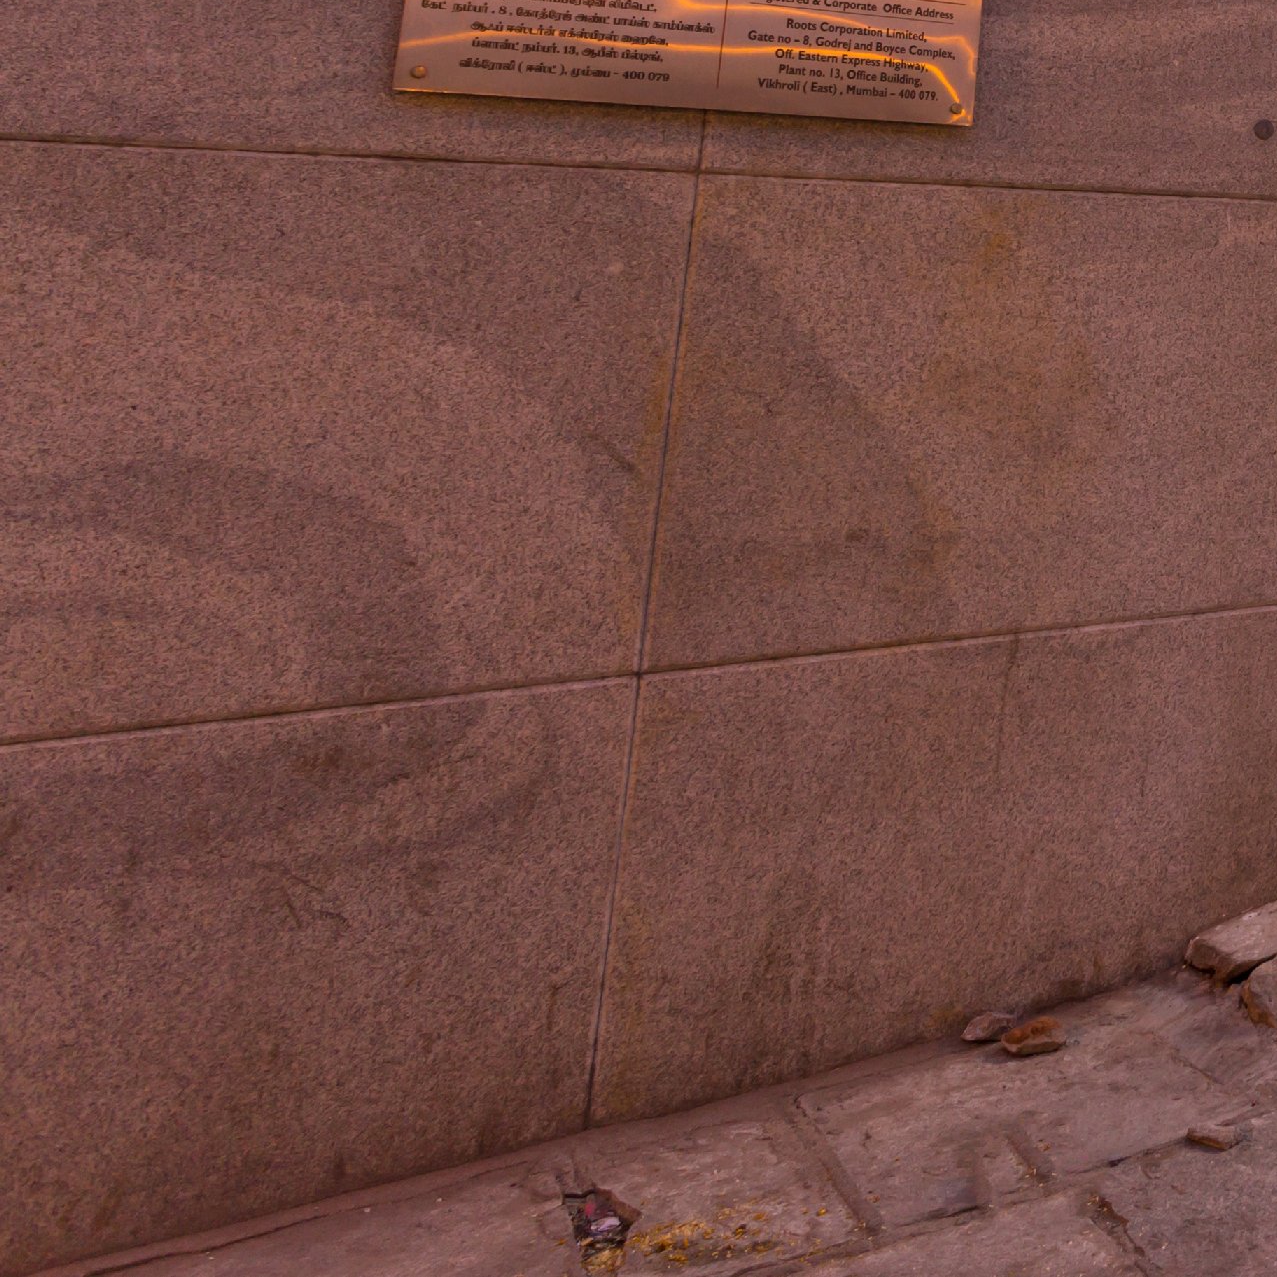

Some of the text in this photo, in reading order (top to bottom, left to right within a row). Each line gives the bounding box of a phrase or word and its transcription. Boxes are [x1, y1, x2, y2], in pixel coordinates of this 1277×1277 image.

[882, 3, 913, 16] Office
[914, 6, 955, 21] Address
[785, 17, 928, 44] Roots Corporation Limited,
[747, 30, 957, 61] Gate no 8, Godrej and Boyce Complex,
[774, 48, 929, 74] Off. Eastern Express Highway,
[778, 64, 924, 88] Plant no. 13, Office Building,
[757, 77, 939, 103] Vikhroli East) Mumbai 400 079.
